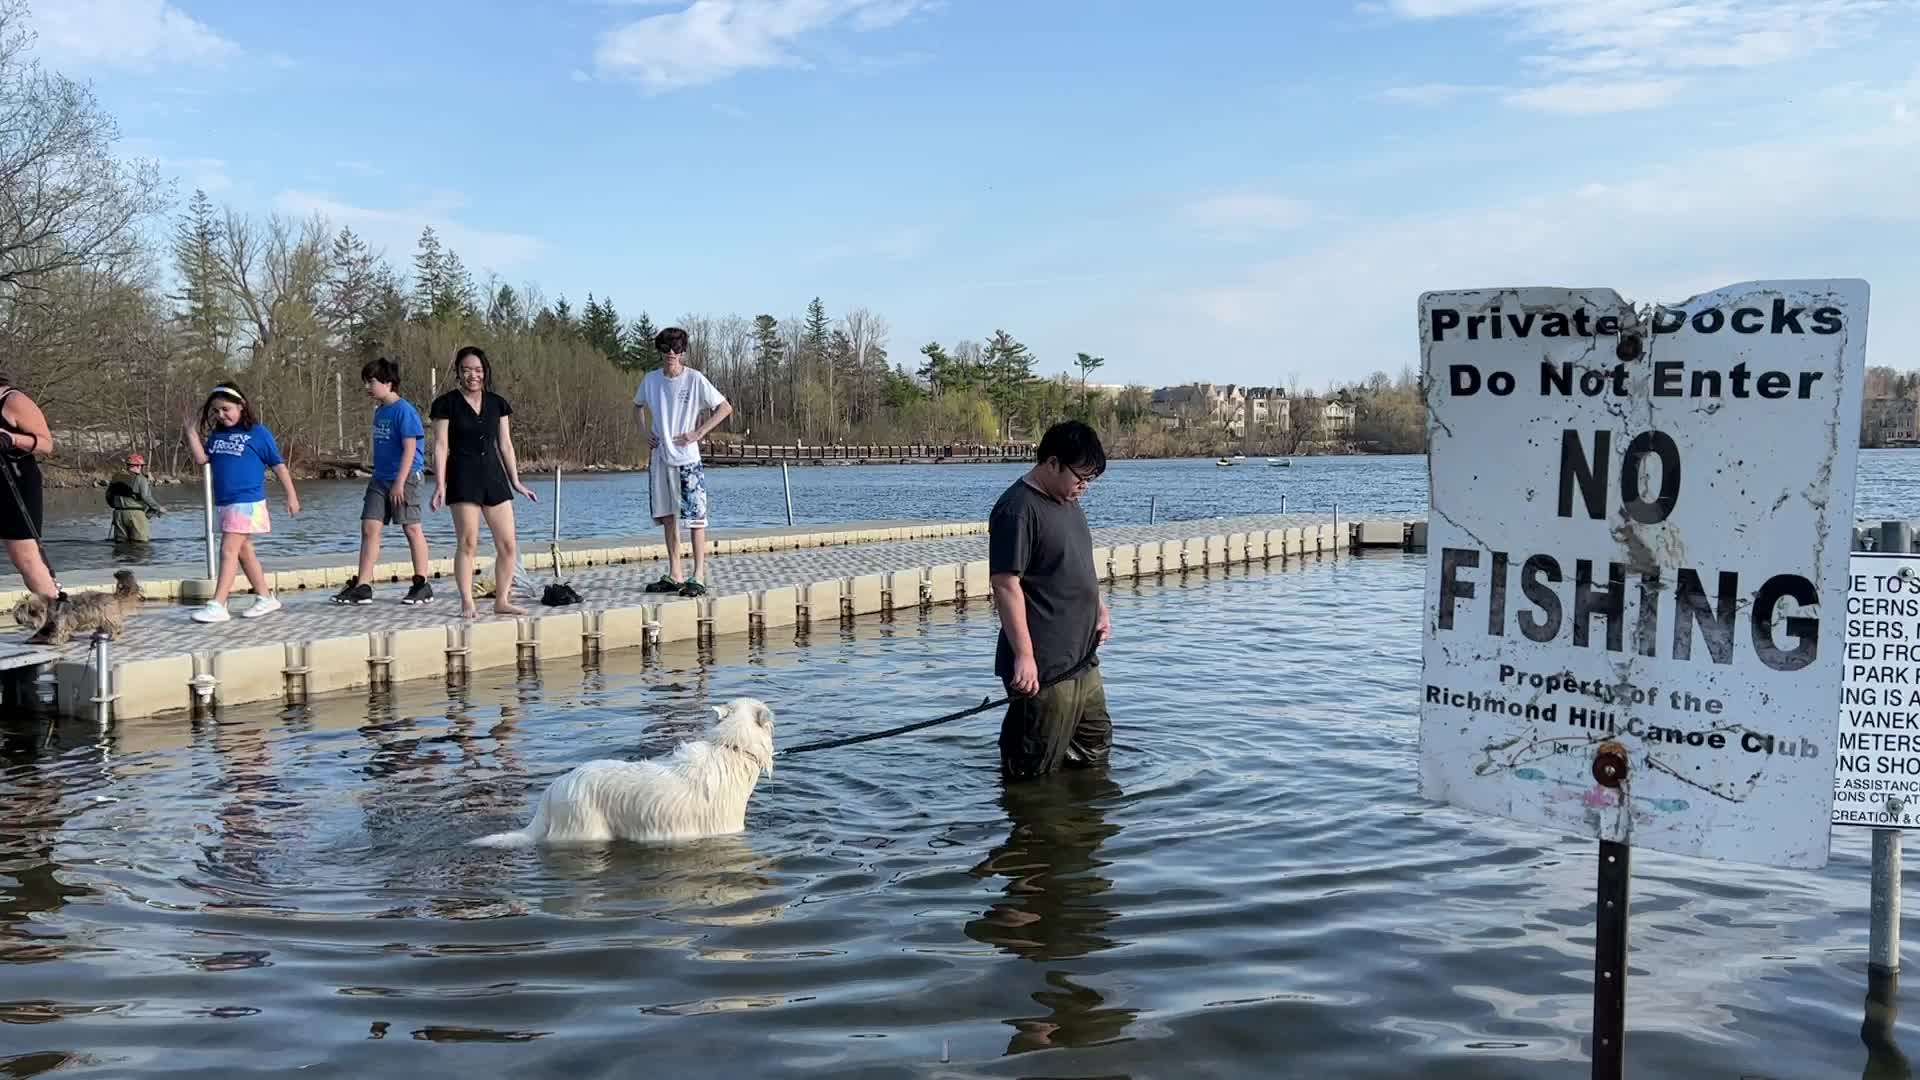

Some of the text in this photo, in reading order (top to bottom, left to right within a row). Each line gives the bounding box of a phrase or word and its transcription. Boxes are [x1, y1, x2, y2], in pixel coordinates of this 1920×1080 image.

[1431, 298, 1843, 342] Private Docks
[1449, 361, 1824, 399] Do Not Enter
[1557, 429, 1681, 525] NO
[1874, 575, 1902, 594] TO
[1438, 547, 1820, 672] FISHING
[1847, 597, 1919, 616] CERNS
[1848, 619, 1909, 641] SERS,
[1853, 665, 1909, 684] PARK
[1499, 664, 1723, 715] Property of the
[1840, 687, 1876, 706] ING
[1884, 690, 1902, 707] IS
[1426, 684, 1820, 759] Richmond Hill Canoe Club
[1849, 710, 1919, 730] VANEK
[1836, 755, 1870, 773] NG
[1844, 778, 1920, 792] ASSISTANC
